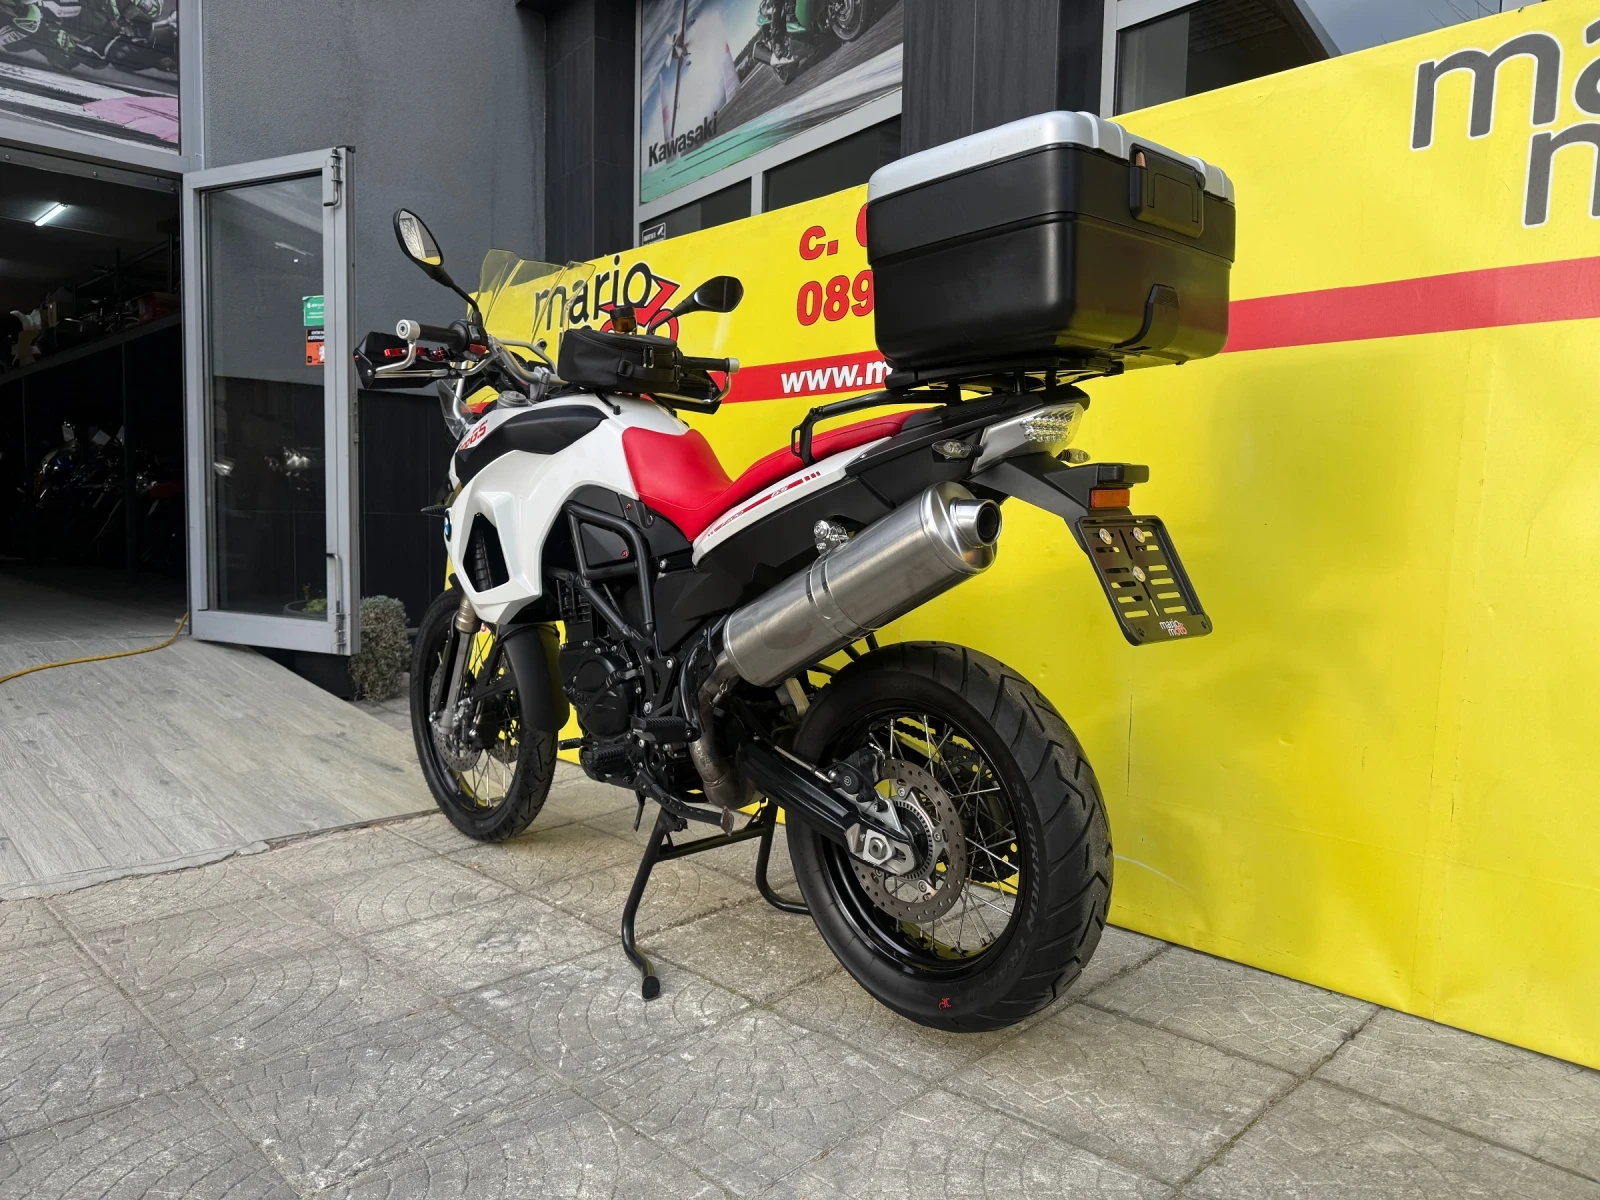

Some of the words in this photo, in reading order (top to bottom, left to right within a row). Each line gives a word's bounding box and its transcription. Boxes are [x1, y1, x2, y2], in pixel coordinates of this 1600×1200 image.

[648, 110, 718, 168] Kawasaki
[532, 254, 652, 333] mario
[1011, 780, 1041, 933] SCORPION
